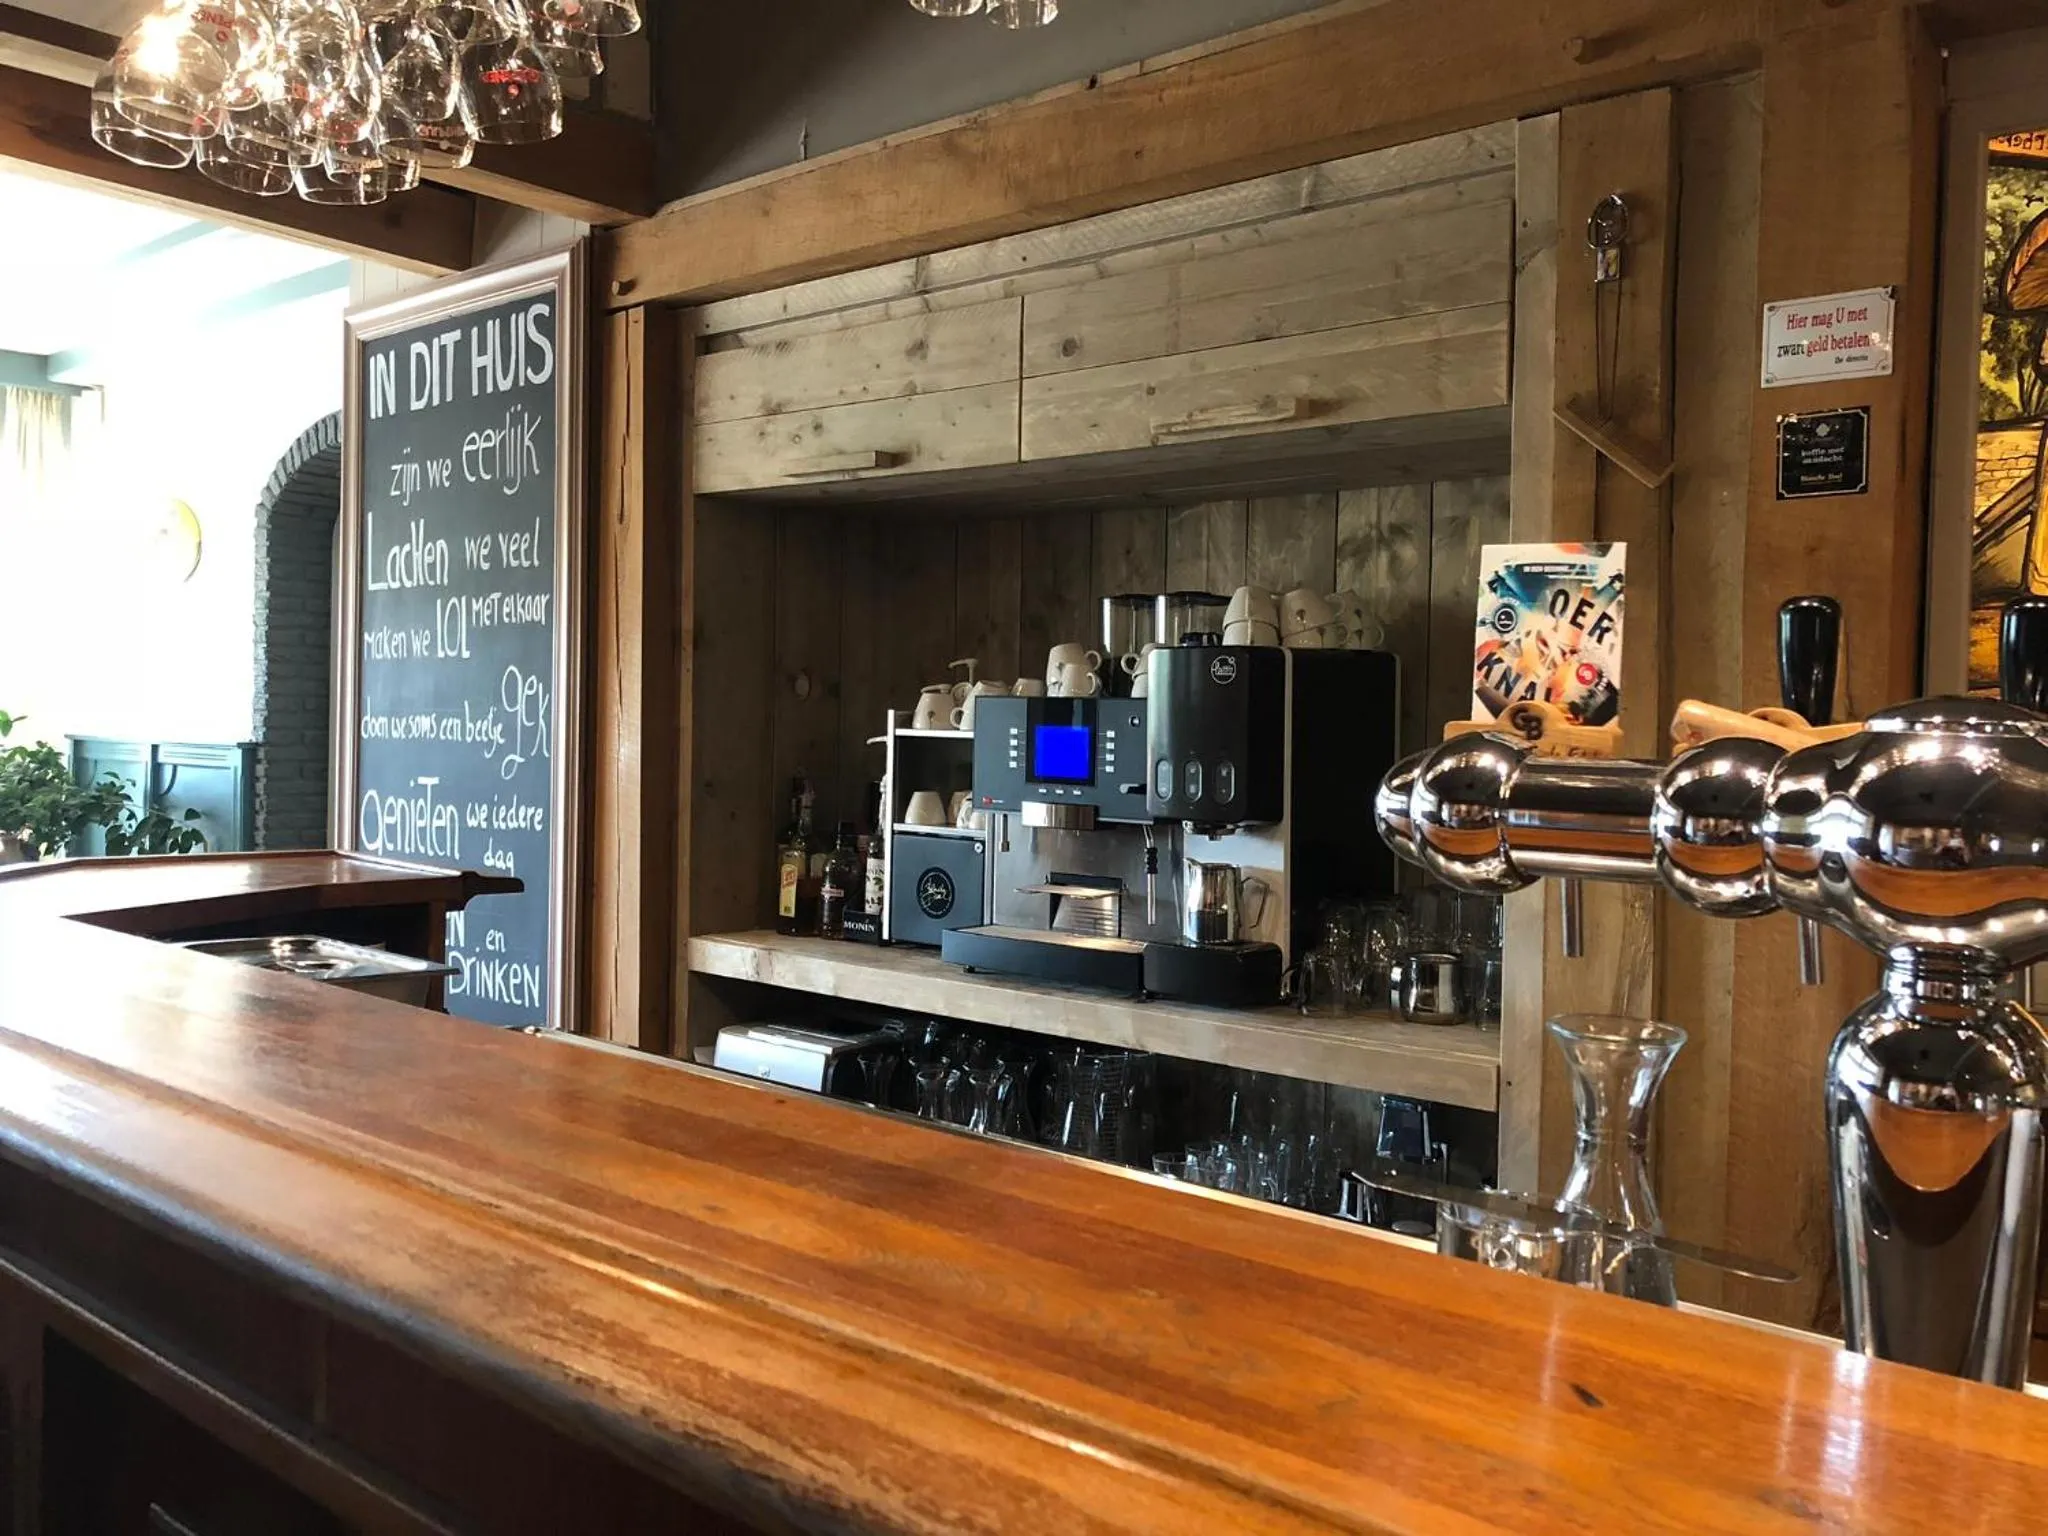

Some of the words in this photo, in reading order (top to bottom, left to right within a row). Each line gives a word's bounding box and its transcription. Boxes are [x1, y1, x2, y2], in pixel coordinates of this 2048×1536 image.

[1786, 313, 1808, 330] Hier
[1811, 312, 1833, 329] mag
[1836, 307, 1845, 323] U
[1847, 307, 1868, 322] met
[369, 350, 396, 419] IN
[410, 329, 462, 411] DIT
[471, 303, 554, 397] HUIS
[1806, 335, 1829, 358] geld
[390, 447, 421, 507] zijn
[427, 458, 452, 489] we
[462, 403, 542, 495] eerlijk
[465, 534, 491, 570] we
[499, 516, 540, 568] veel
[411, 628, 431, 657] we
[502, 592, 550, 625] elkaar
[1550, 588, 1614, 645] OER
[361, 695, 389, 739] doen
[391, 715, 406, 739] we
[408, 712, 437, 739] soms
[439, 715, 462, 742] een
[501, 664, 550, 780] gek
[467, 803, 487, 829] we
[491, 794, 544, 832] iedere
[483, 837, 515, 877] dag
[485, 928, 506, 953] en
